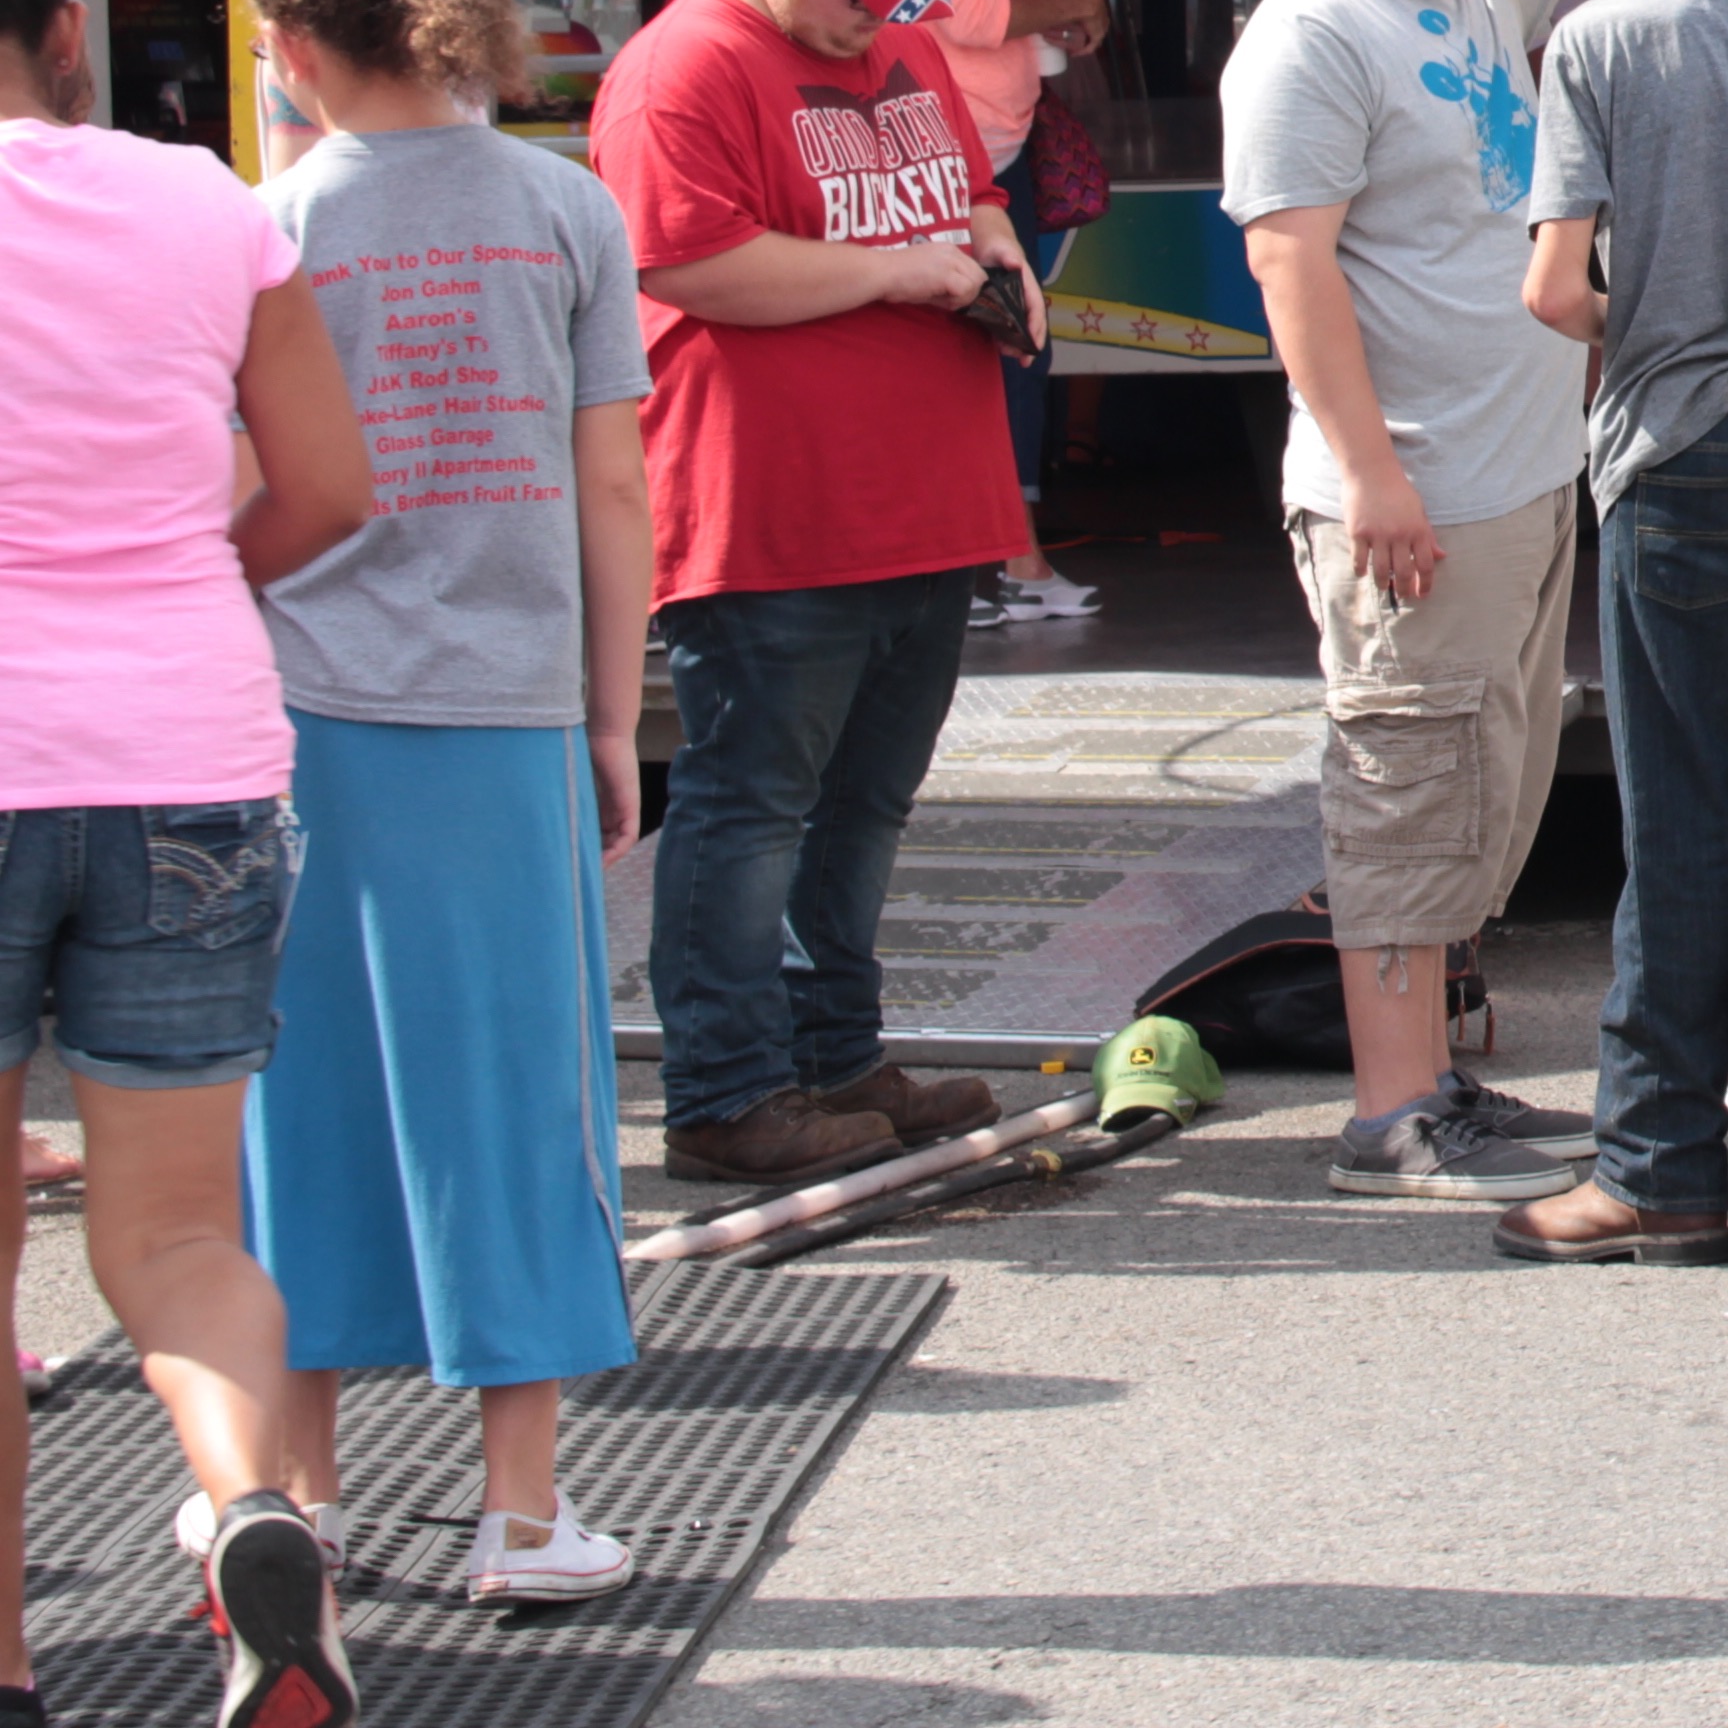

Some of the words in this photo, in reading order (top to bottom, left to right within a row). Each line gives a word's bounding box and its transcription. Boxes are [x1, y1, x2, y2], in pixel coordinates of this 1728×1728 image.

[819, 156, 970, 242] BUCKEYES
[311, 263, 353, 289] ank
[357, 255, 392, 273] You
[396, 254, 419, 270] to
[426, 247, 466, 267] Our
[472, 244, 565, 267] Sponsors
[381, 286, 415, 303] Jon
[421, 279, 482, 298] Gahm
[385, 308, 477, 332] Aaron's
[376, 339, 457, 362] Tiffany's
[366, 374, 404, 396] J&K
[409, 369, 449, 389] Rod
[456, 365, 499, 386] Shop
[444, 396, 483, 414] Hair
[486, 394, 545, 413] Studio
[375, 434, 426, 454] Glass
[430, 427, 495, 447] Garage
[431, 456, 536, 479] Apartments
[397, 489, 470, 515] Brothers
[474, 484, 516, 504] Fruit
[522, 483, 563, 502] Farm
